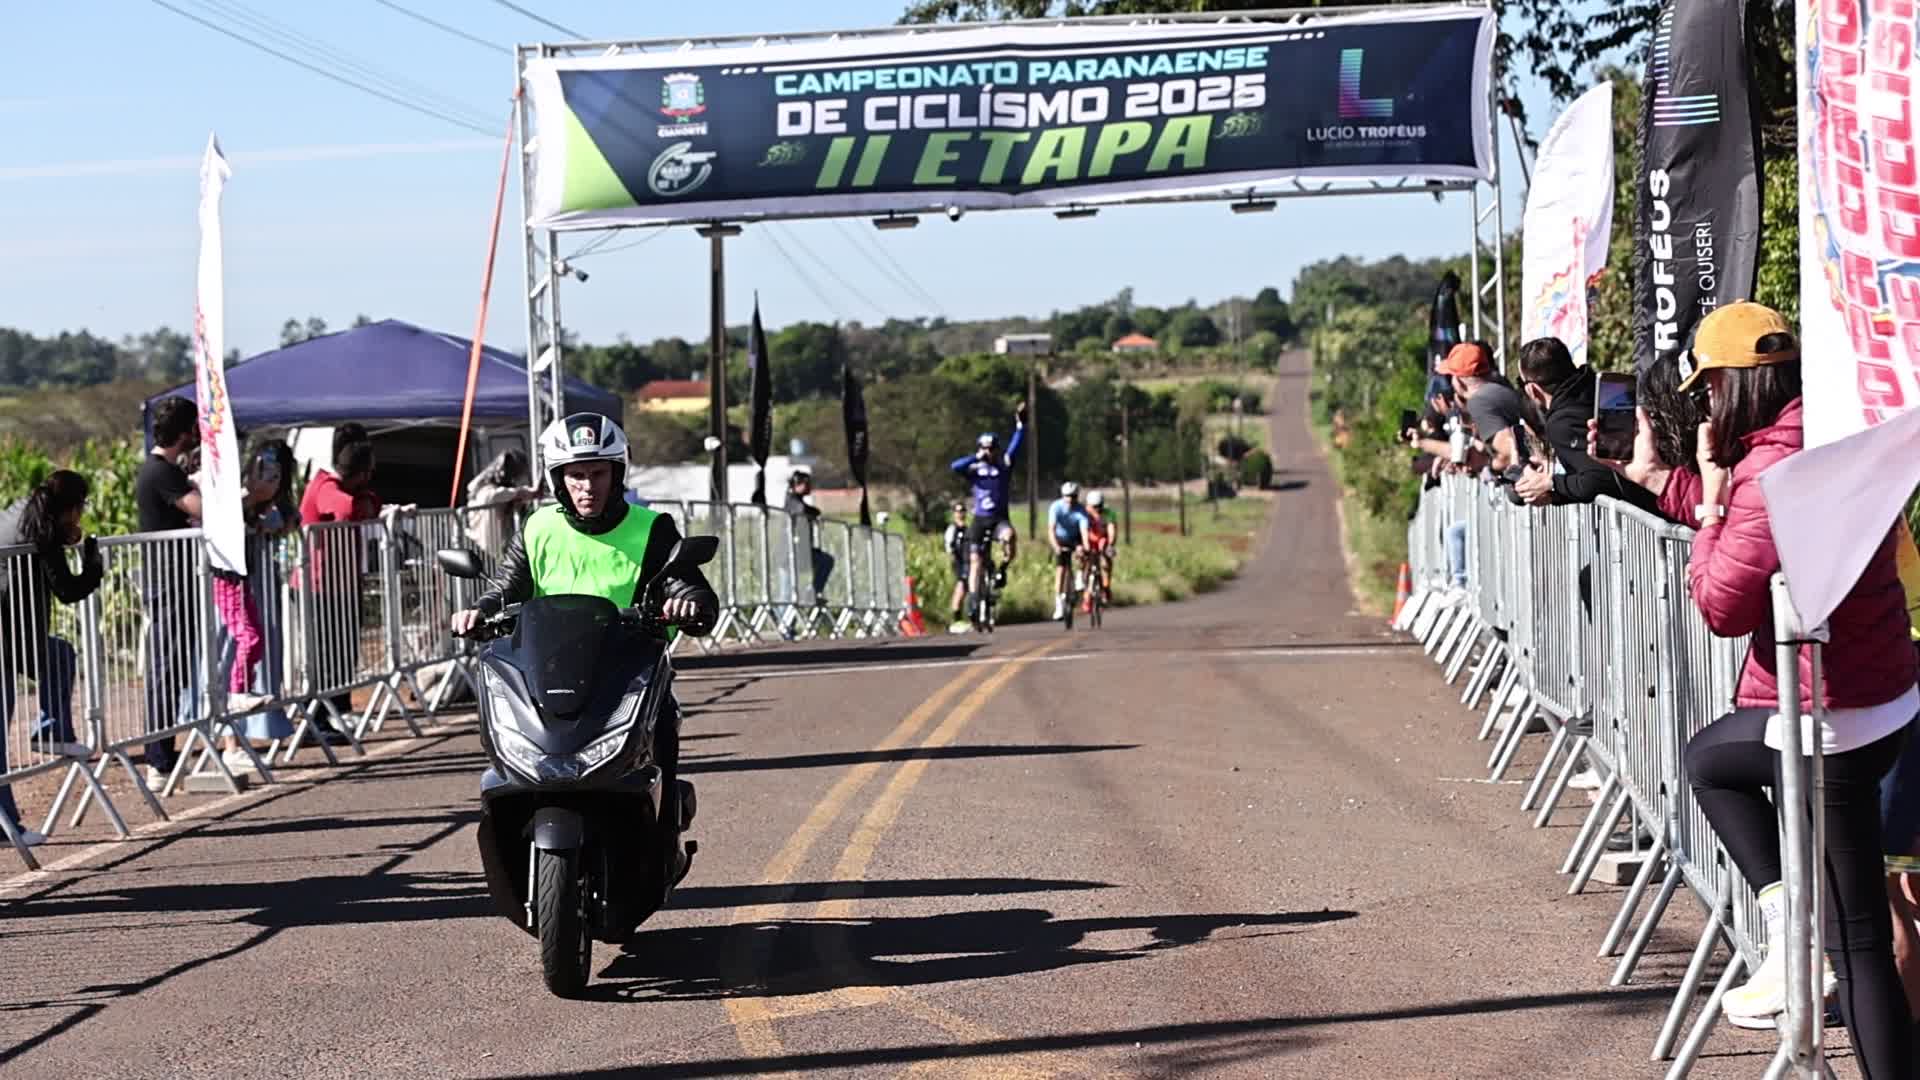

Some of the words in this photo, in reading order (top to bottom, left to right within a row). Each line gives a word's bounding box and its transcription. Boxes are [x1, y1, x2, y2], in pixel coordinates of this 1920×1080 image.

[775, 60, 1019, 96] CAMPEONATO
[1028, 46, 1269, 86] PARANAENSE
[776, 98, 848, 137] DE
[863, 83, 1110, 132] CICLÍSMO
[1124, 72, 1267, 119] 2025
[814, 134, 892, 189] II
[911, 113, 1214, 185] ETAPA
[1306, 126, 1355, 141] LUCIO
[1649, 168, 1680, 361] ROFÉUS
[1695, 222, 1716, 291] QUISER!
